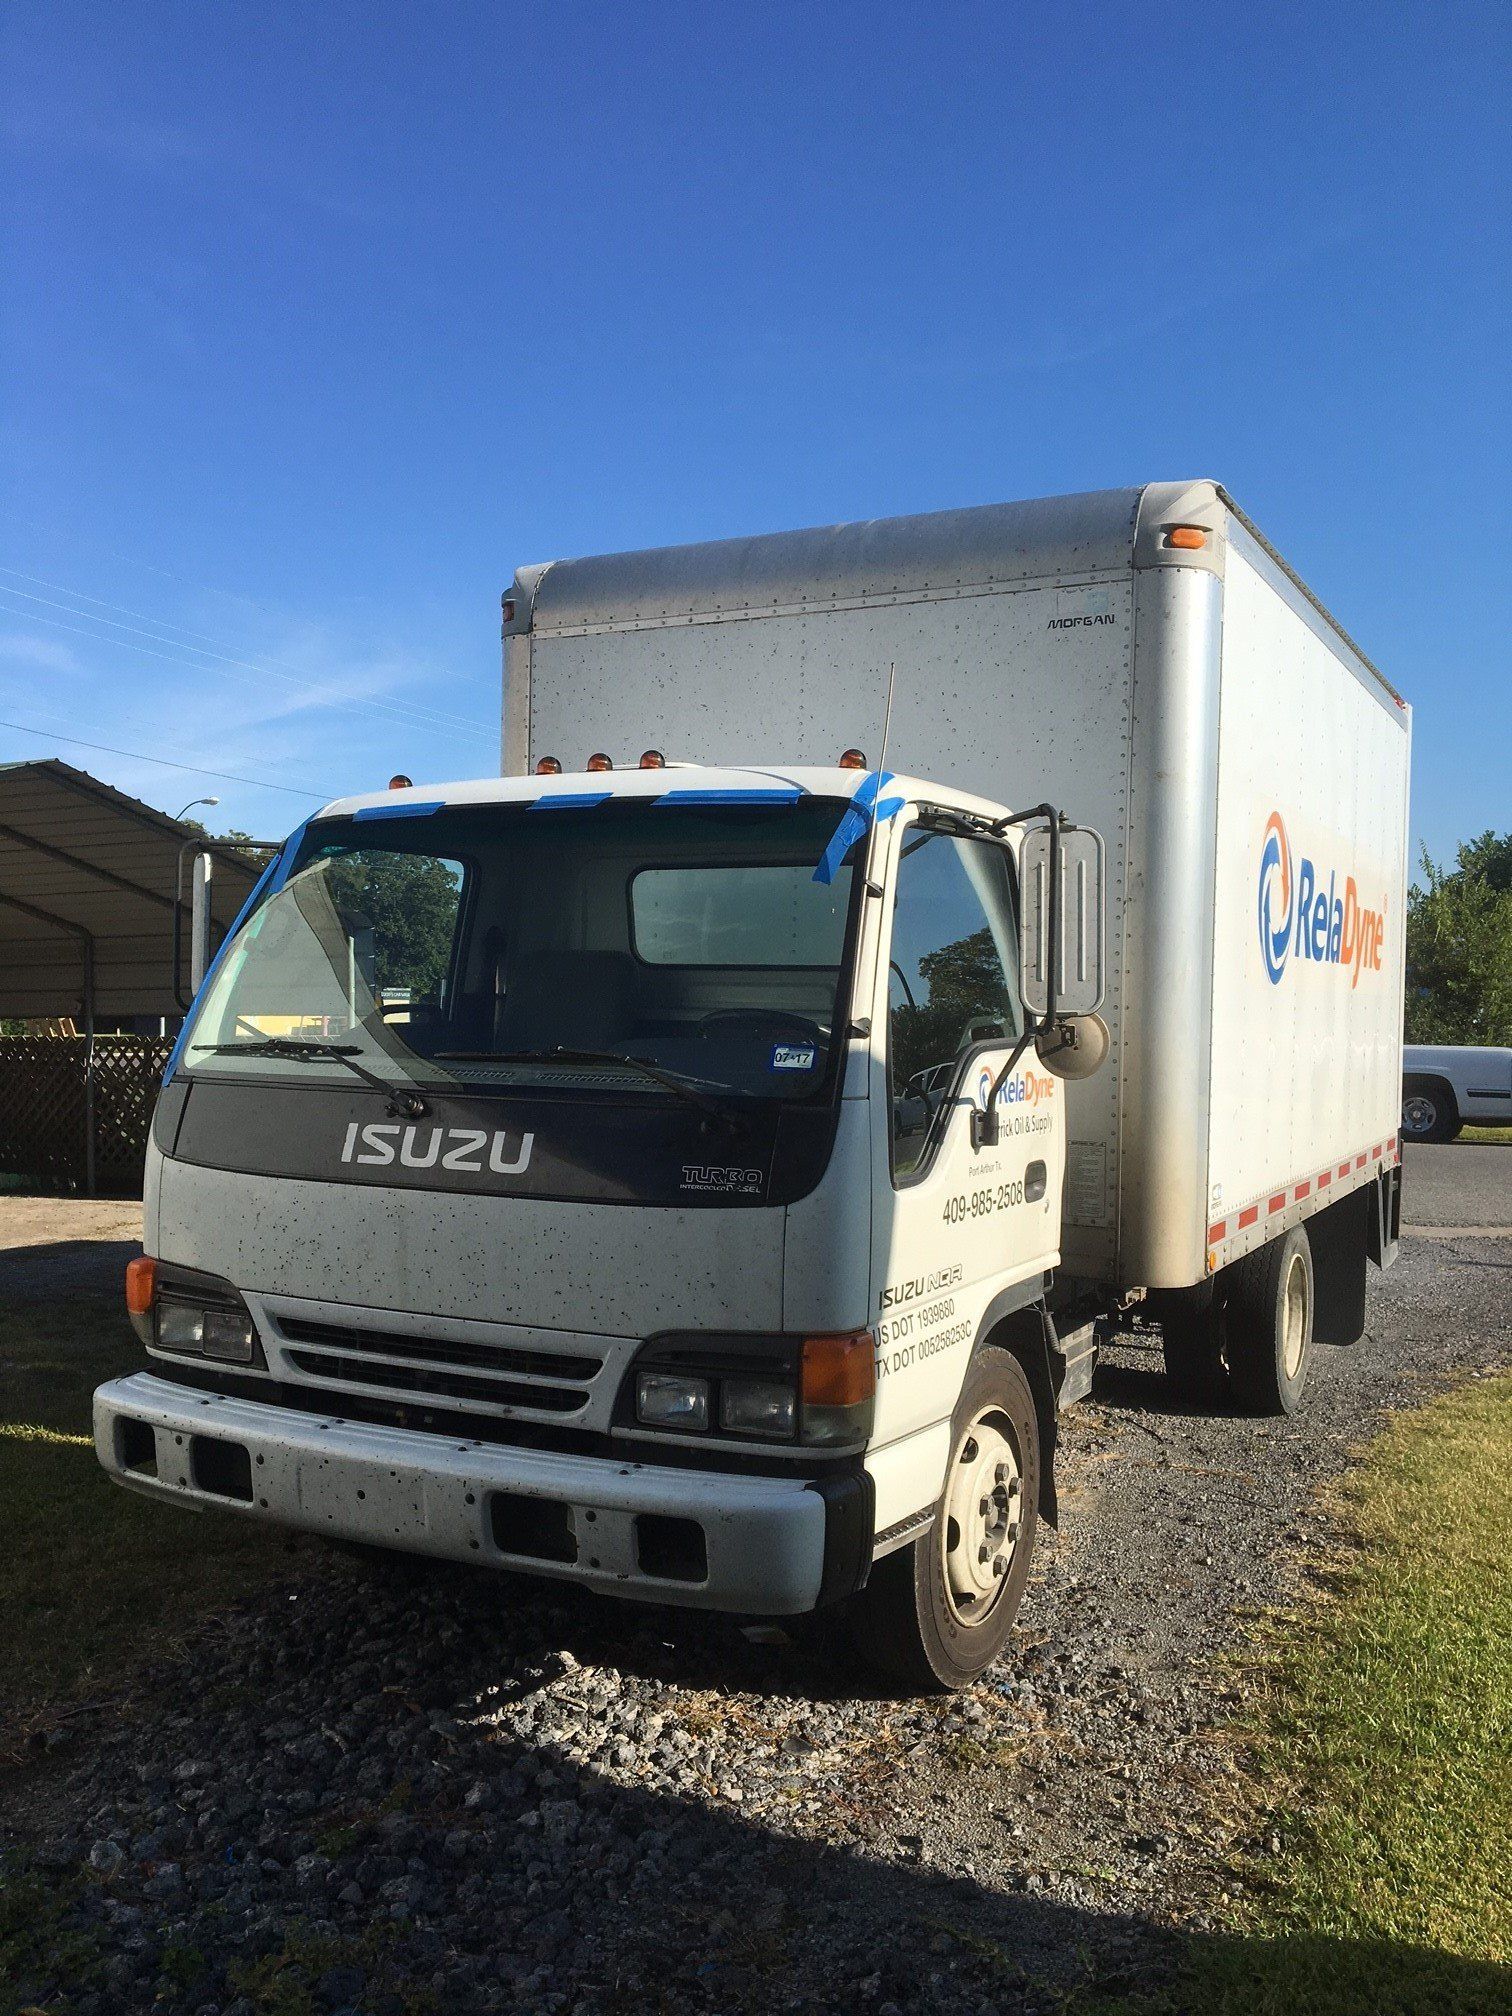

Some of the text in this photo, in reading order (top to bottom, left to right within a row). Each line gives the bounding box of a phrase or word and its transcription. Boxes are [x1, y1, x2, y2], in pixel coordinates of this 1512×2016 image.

[1047, 614, 1115, 630] MORGAN
[1294, 857, 1384, 990] RelaDyne
[999, 1071, 1055, 1108] RelaDyne
[341, 1122, 535, 1174] ISUZU
[998, 1112, 1054, 1138] rick Oil & Supply
[682, 1165, 763, 1184] TURBO
[943, 1180, 1023, 1226] 409-985-2508
[879, 1263, 963, 1310] ISUZU NQR
[872, 1298, 955, 1349] US DOT 1939880
[874, 1319, 972, 1380] TX DOT 005258253C
